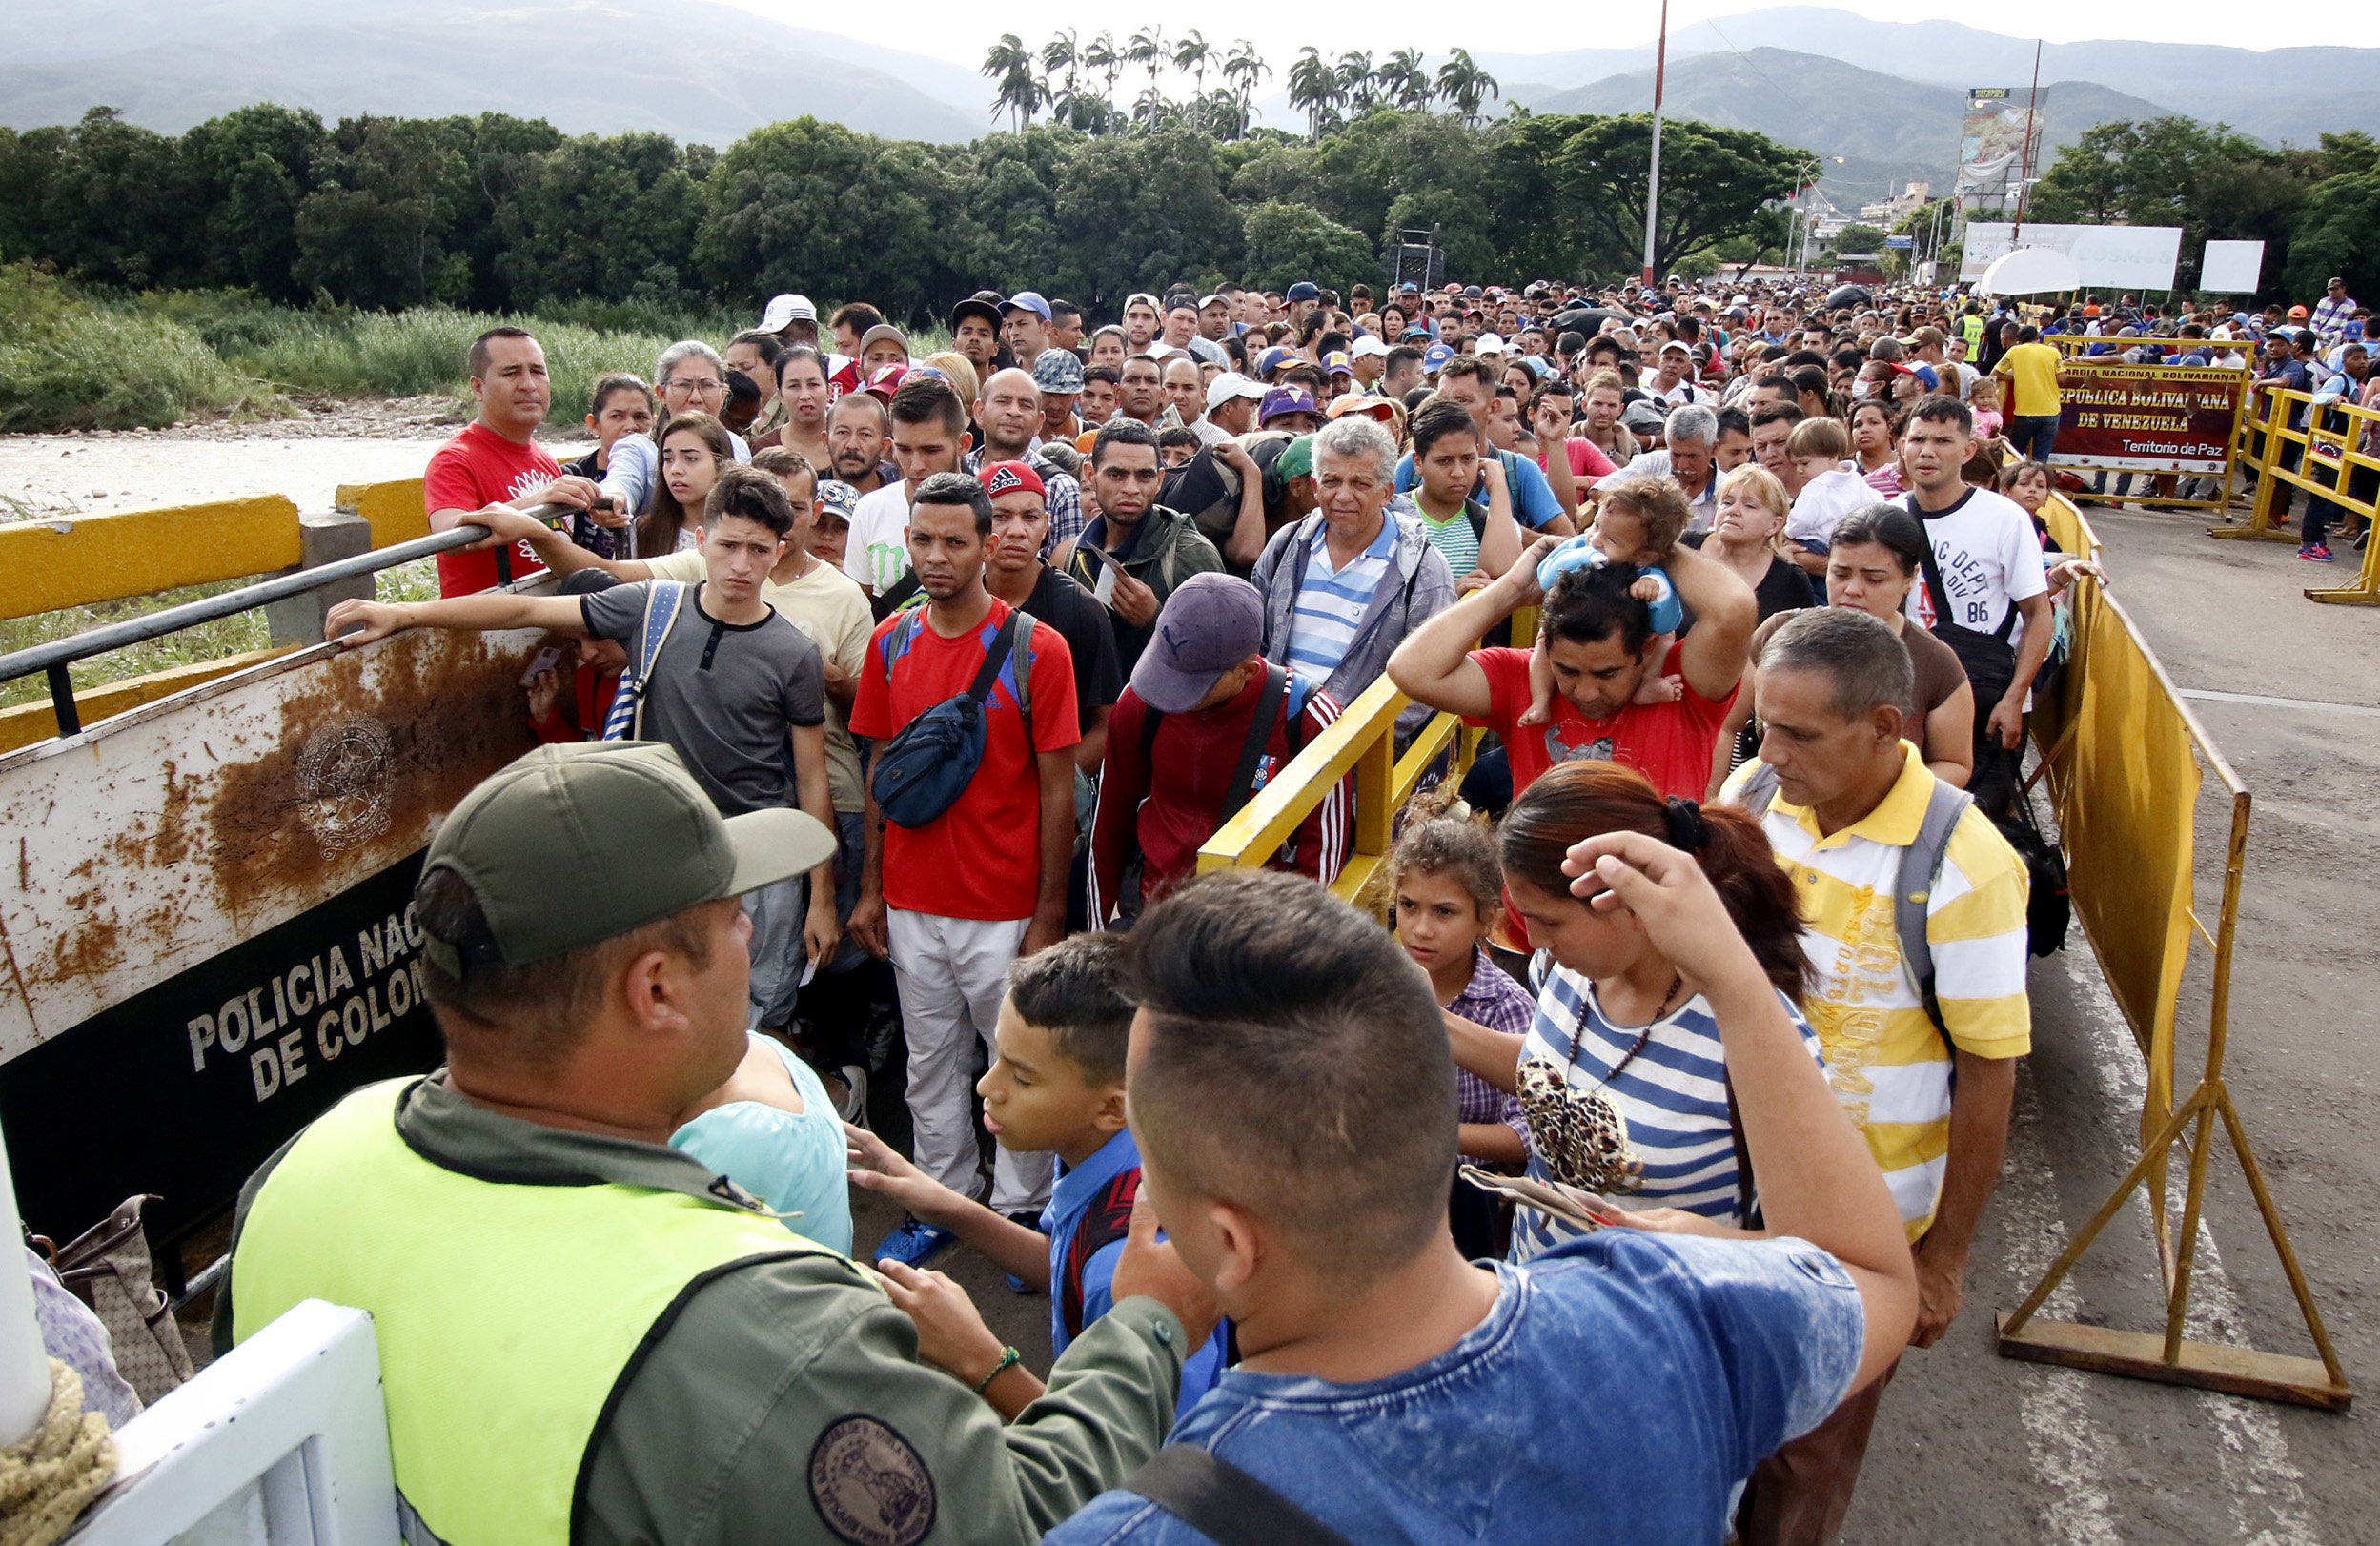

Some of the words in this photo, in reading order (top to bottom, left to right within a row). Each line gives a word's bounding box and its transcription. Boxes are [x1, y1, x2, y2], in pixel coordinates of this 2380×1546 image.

[2102, 369, 2157, 378] NACIONAL
[2162, 371, 2236, 381] BOLIVARIANA
[2077, 412, 2099, 428] DE
[2103, 413, 2189, 432] VENEZUELA
[2123, 439, 2178, 455] Territorio
[2180, 442, 2196, 455] de
[2198, 443, 2223, 457] Paz
[988, 478, 1021, 493] adidas
[1951, 549, 1989, 596] DEPT
[1946, 575, 1969, 598] DIV
[1967, 600, 1989, 624] 86
[187, 945, 355, 1072] POLICIA
[250, 1027, 308, 1103] DE
